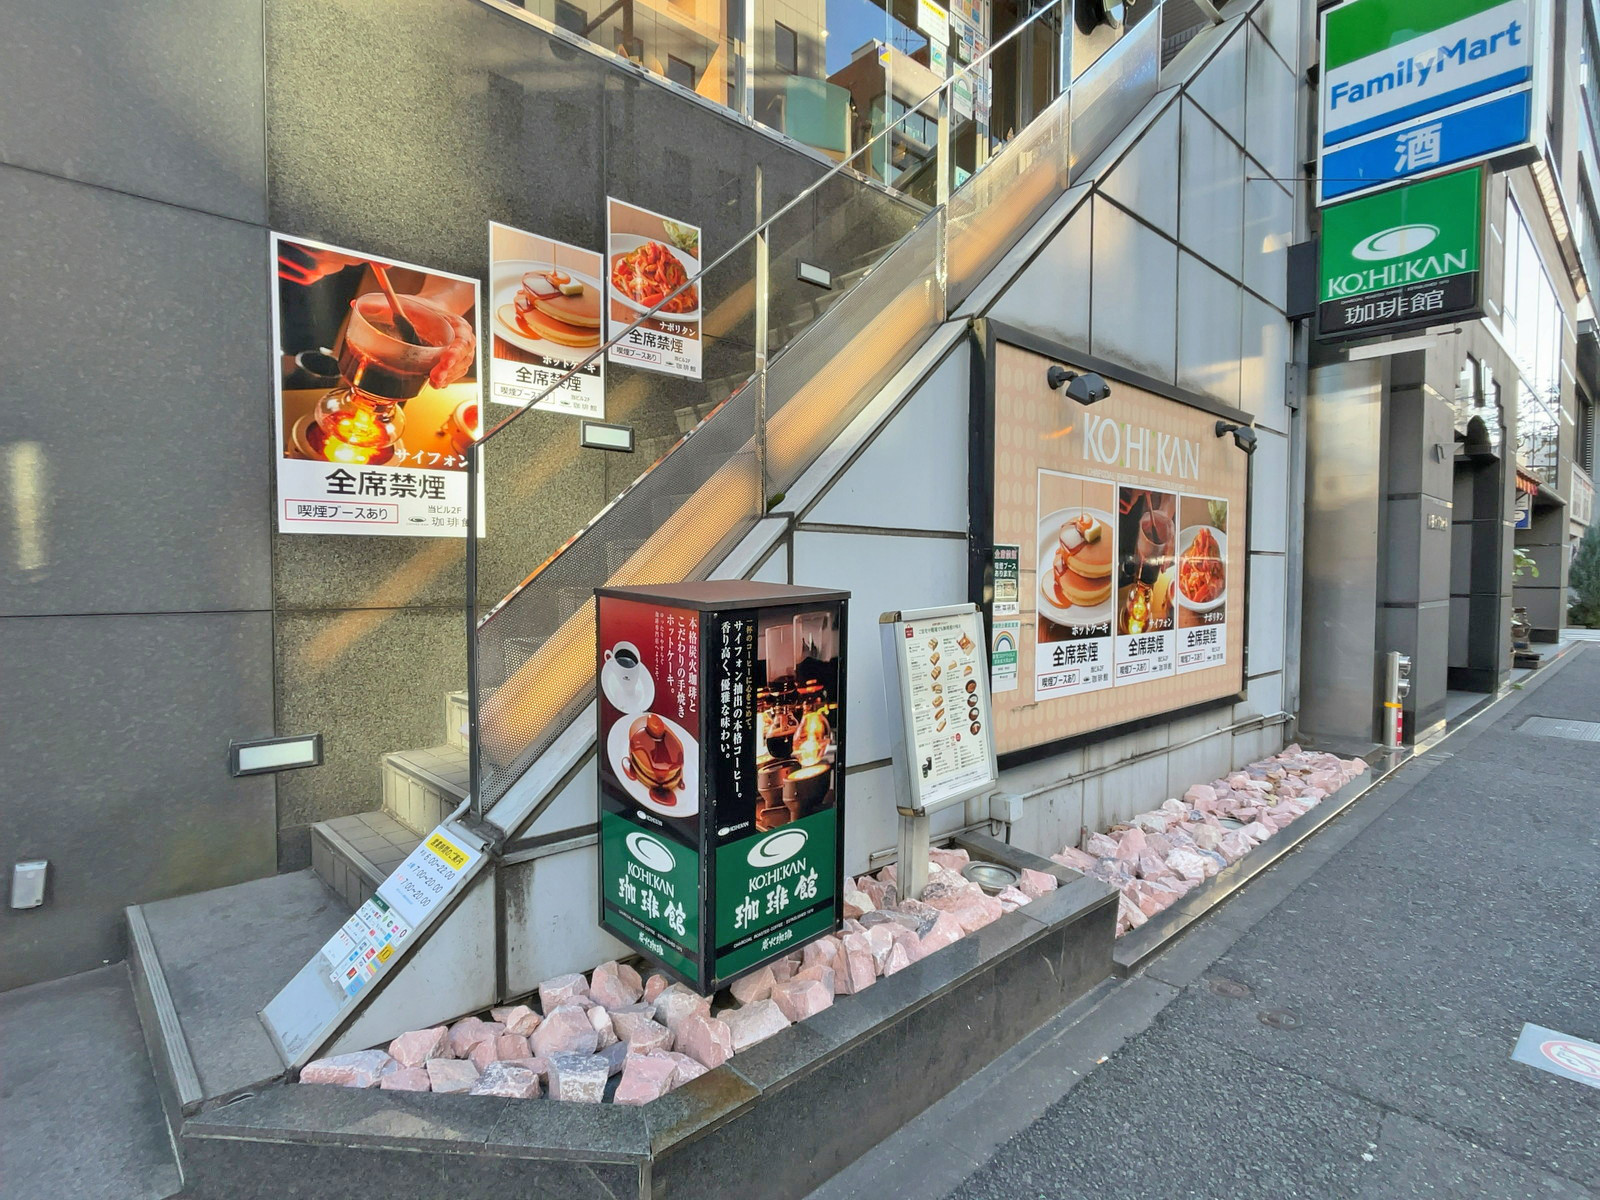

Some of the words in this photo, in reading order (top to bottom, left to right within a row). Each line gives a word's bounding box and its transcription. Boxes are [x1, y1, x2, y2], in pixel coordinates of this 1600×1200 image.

[1330, 20, 1522, 110] FamilyMart
[1393, 122, 1443, 173] 酒
[1344, 289, 1445, 325] 珈琲館
[629, 329, 683, 354] 全席禁煙
[659, 321, 696, 337] ナポリタン
[394, 448, 469, 468] サイフォン
[325, 468, 446, 500] 全席禁煙
[297, 504, 389, 520] 喫煙ブースあり
[427, 505, 462, 515] 当ビル2F
[666, 613, 675, 694] ホットケーキ。
[1053, 642, 1098, 667] 全席禁煙
[1128, 635, 1164, 657] 全席禁煙
[1187, 628, 1218, 647] 全席禁煙
[677, 615, 686, 719] こだわりの手焼き
[688, 616, 698, 713] 本格炭火珈琲と
[720, 620, 731, 759] 香り高く、優雅な味わい。
[733, 620, 743, 798] サイフォン抽出の本格コーヒー。
[618, 874, 687, 937] 珈琲館
[733, 866, 819, 930] 珈琲館
